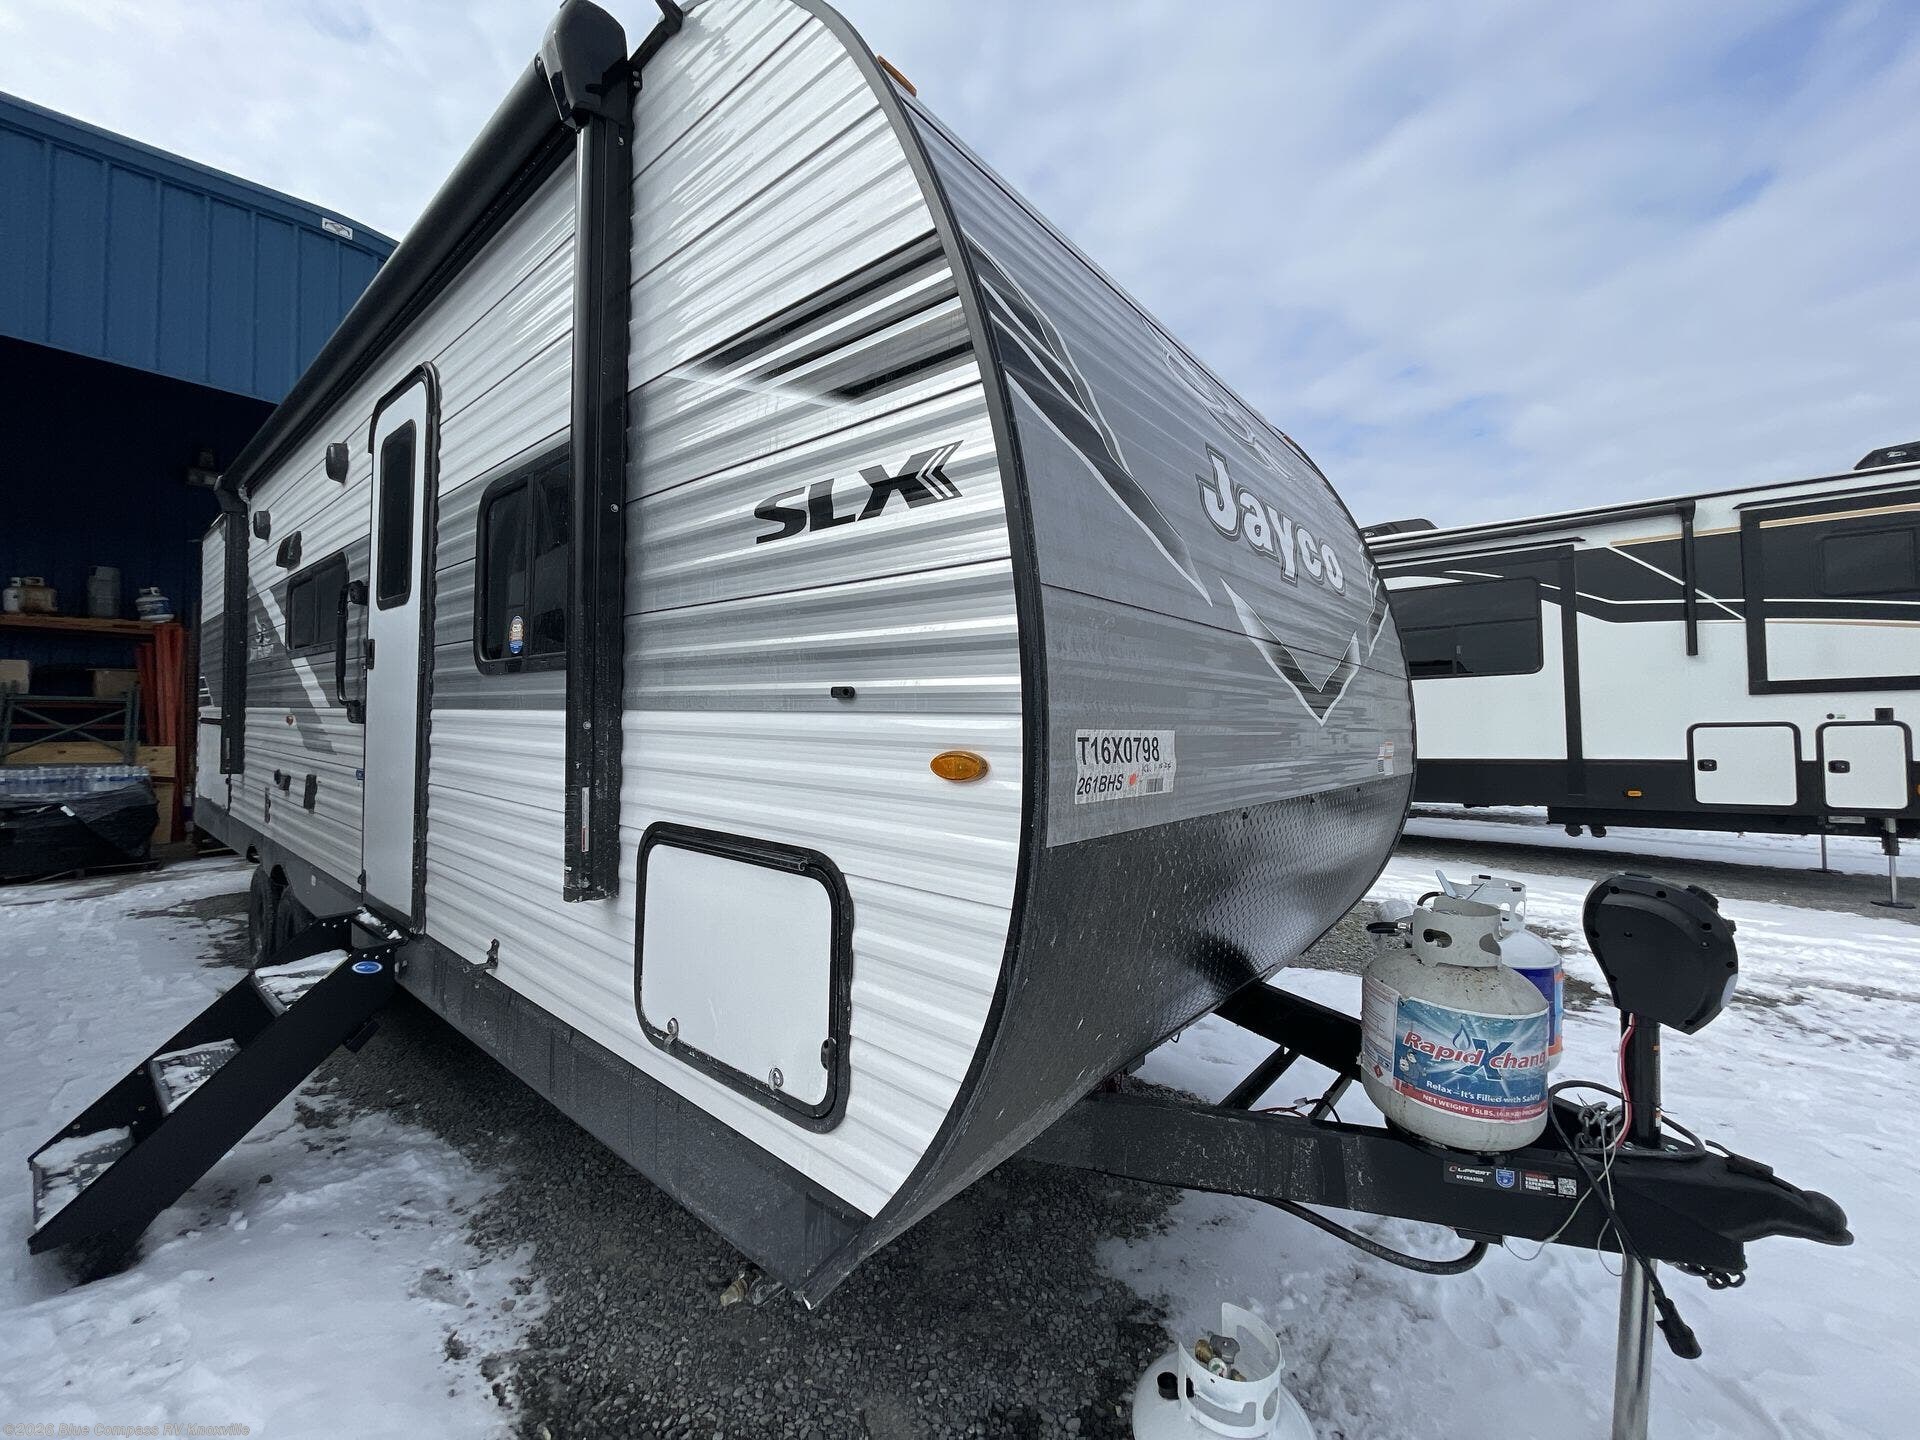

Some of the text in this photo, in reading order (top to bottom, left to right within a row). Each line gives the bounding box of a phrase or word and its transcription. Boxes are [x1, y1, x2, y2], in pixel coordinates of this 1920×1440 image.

[754, 440, 964, 544] SLX
[1195, 442, 1346, 596] Jayco
[1077, 737, 1160, 765] T16X0798
[1077, 774, 1124, 796] 261BHS
[1422, 1094, 1438, 1105] NET
[1438, 1099, 1470, 1113] WEIGHT
[1477, 1094, 1502, 1103] Filled
